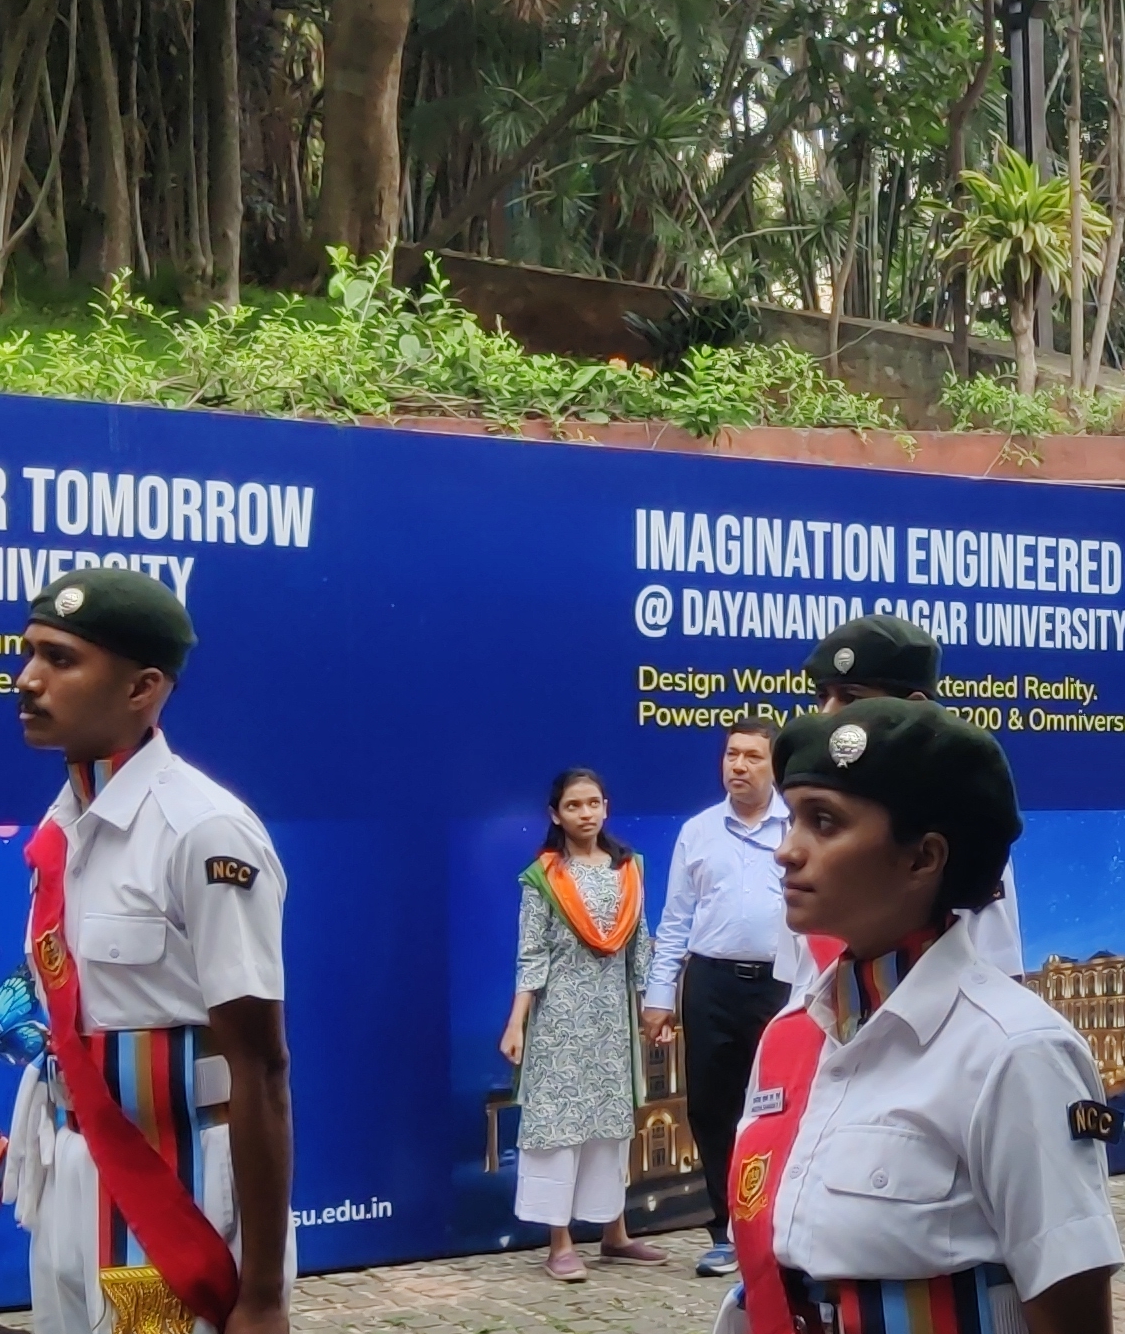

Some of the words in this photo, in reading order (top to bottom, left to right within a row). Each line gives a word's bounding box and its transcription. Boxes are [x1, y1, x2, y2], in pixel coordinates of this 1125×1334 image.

[23, 467, 314, 548] TOMORROW
[636, 508, 895, 584] IMAGINATION
[907, 527, 1122, 595] ENGINEERED
[635, 584, 673, 638] @
[639, 665, 725, 698] Design
[937, 674, 1018, 698] xtended
[1024, 676, 1098, 705] Reality.
[1007, 708, 1024, 731] &
[213, 860, 251, 882] NCC
[1076, 1107, 1112, 1134] NCC
